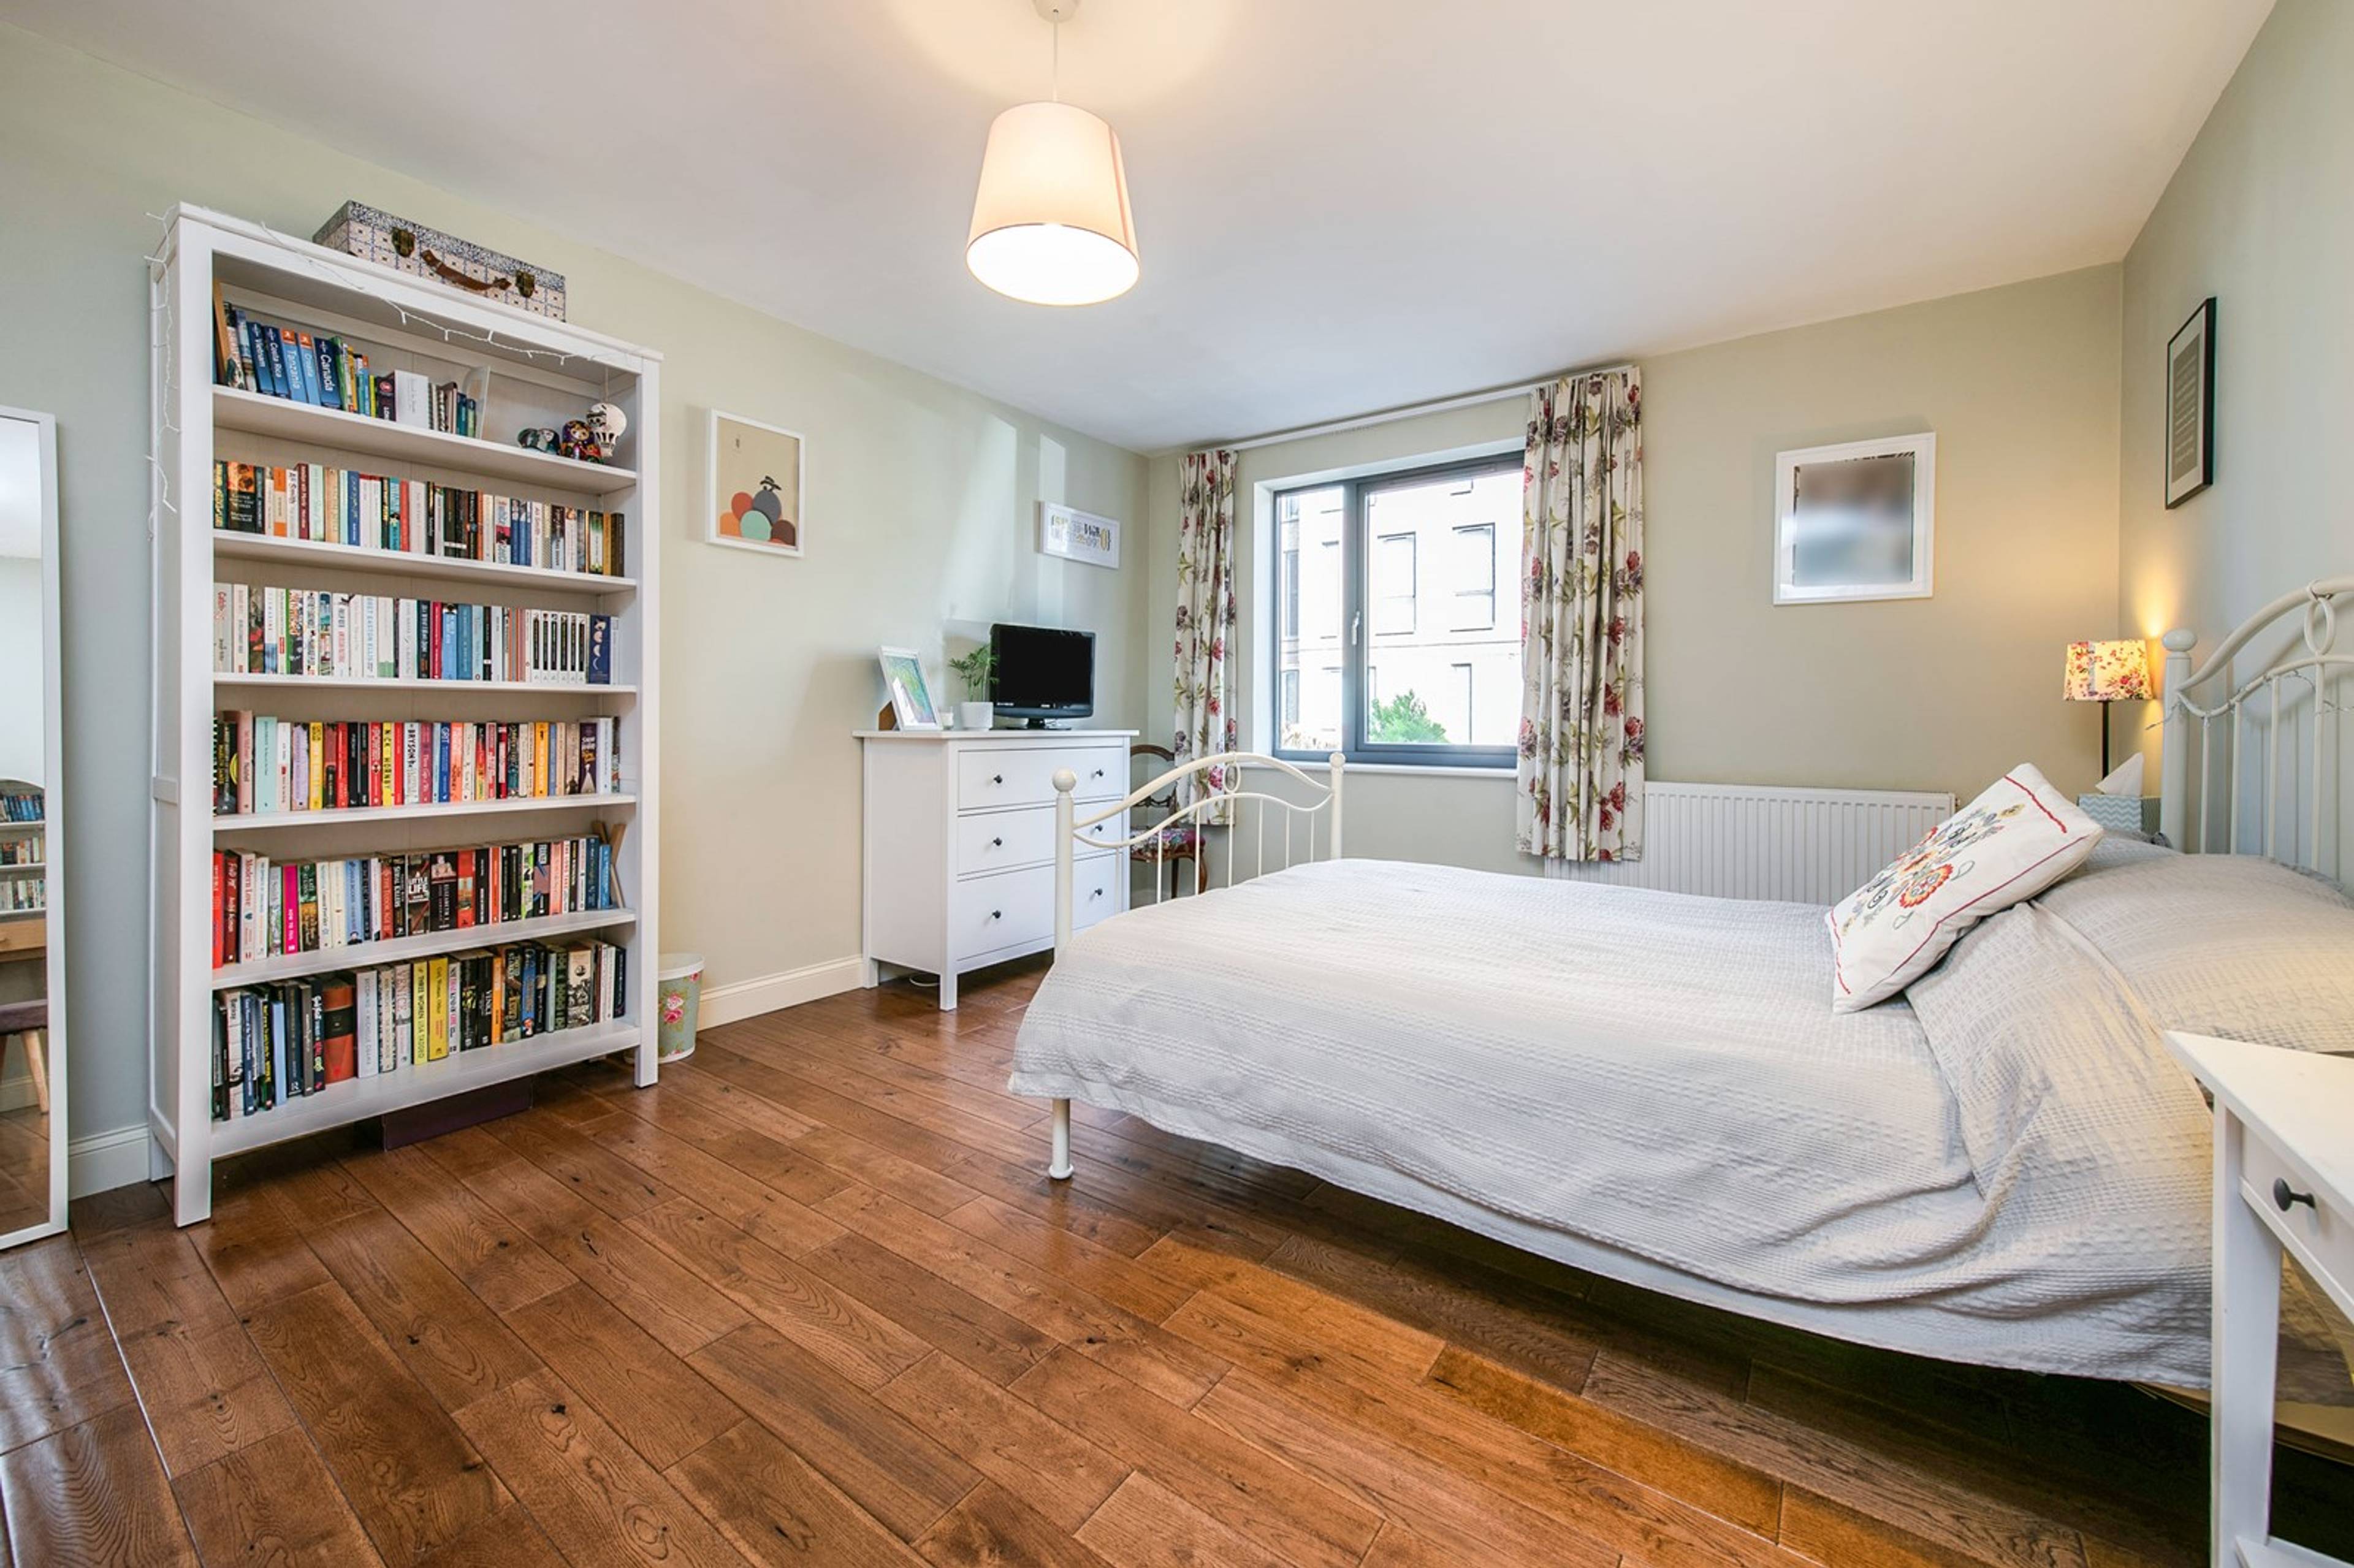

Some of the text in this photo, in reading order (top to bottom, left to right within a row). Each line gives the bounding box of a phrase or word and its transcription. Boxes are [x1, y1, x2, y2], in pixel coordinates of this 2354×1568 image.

[254, 338, 265, 367] Vietnam
[270, 343, 280, 361] Costa
[288, 350, 301, 389] Tanzania
[321, 354, 335, 391] Canada
[397, 970, 408, 1011] VENICE
